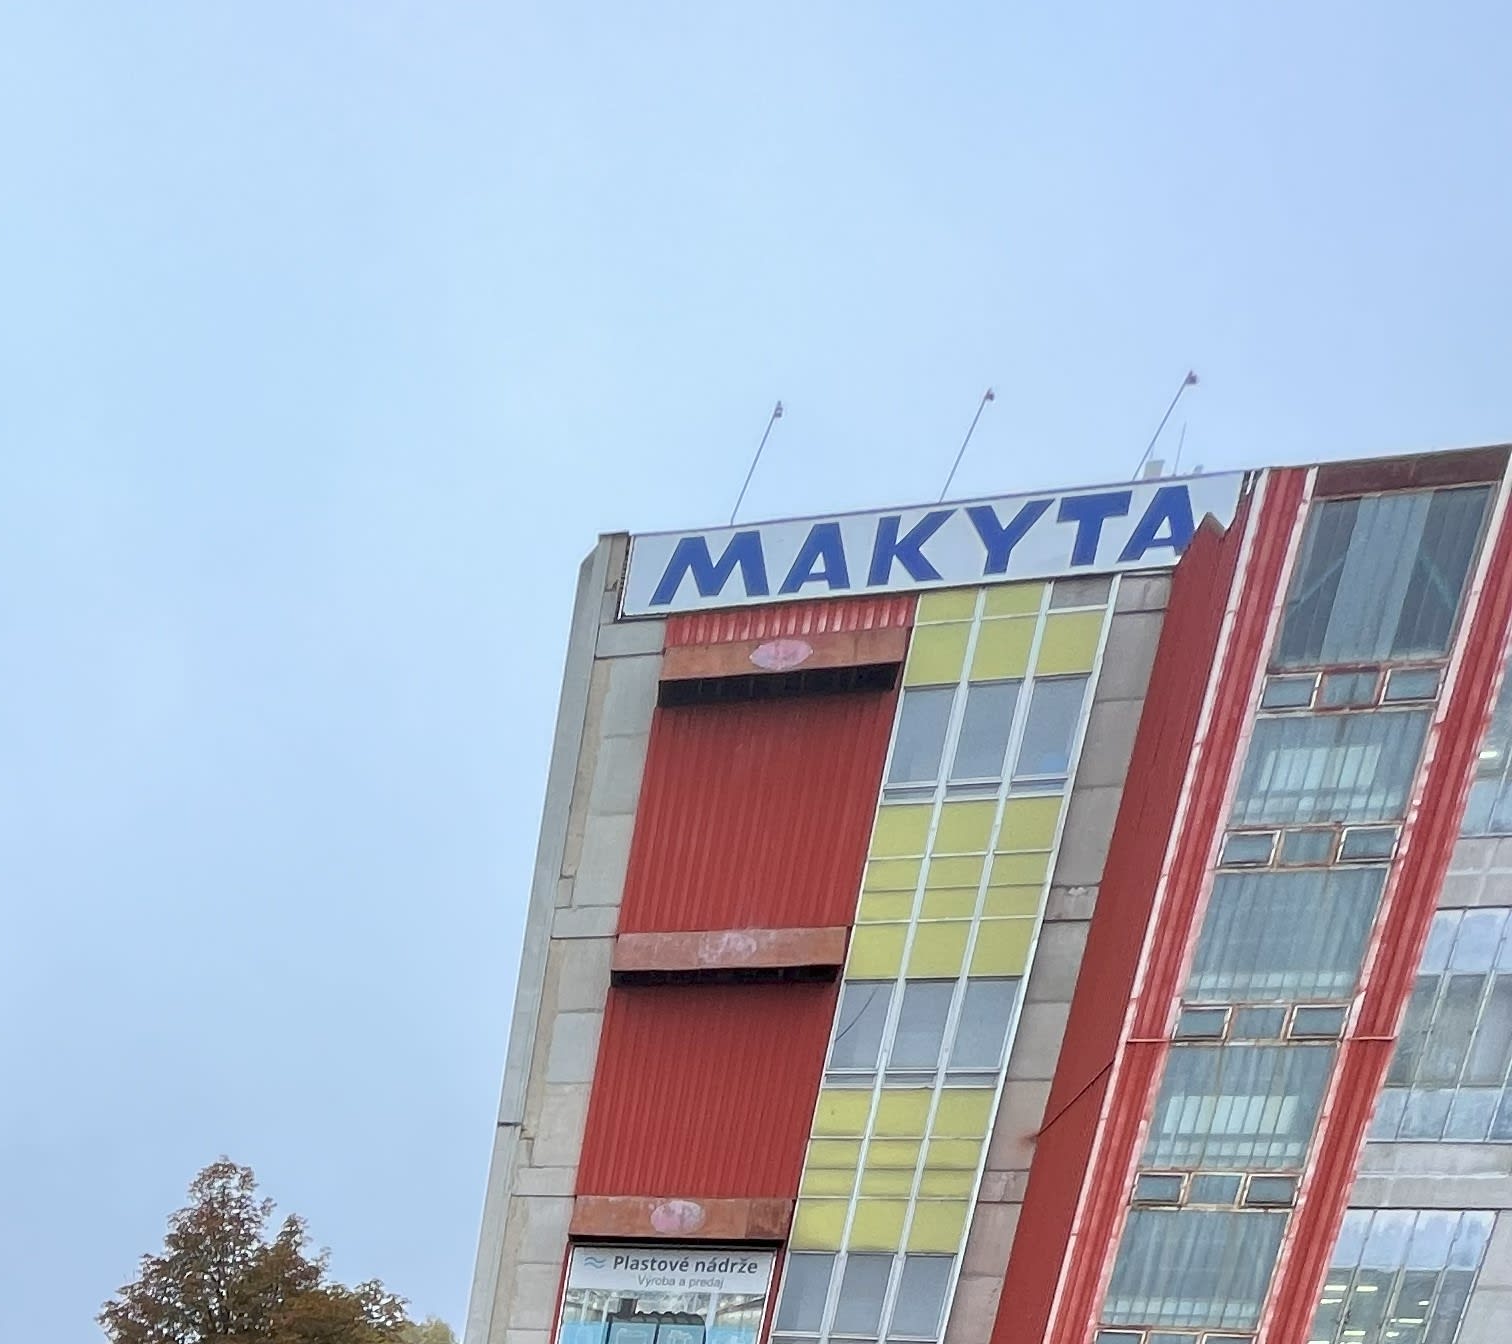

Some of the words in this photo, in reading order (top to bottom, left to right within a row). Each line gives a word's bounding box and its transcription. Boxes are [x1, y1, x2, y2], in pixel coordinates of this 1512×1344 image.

[649, 485, 1195, 607] MAKYTA
[613, 1255, 690, 1273] Plastové
[694, 1257, 759, 1275] nádrže
[688, 1276, 725, 1289] predaj
